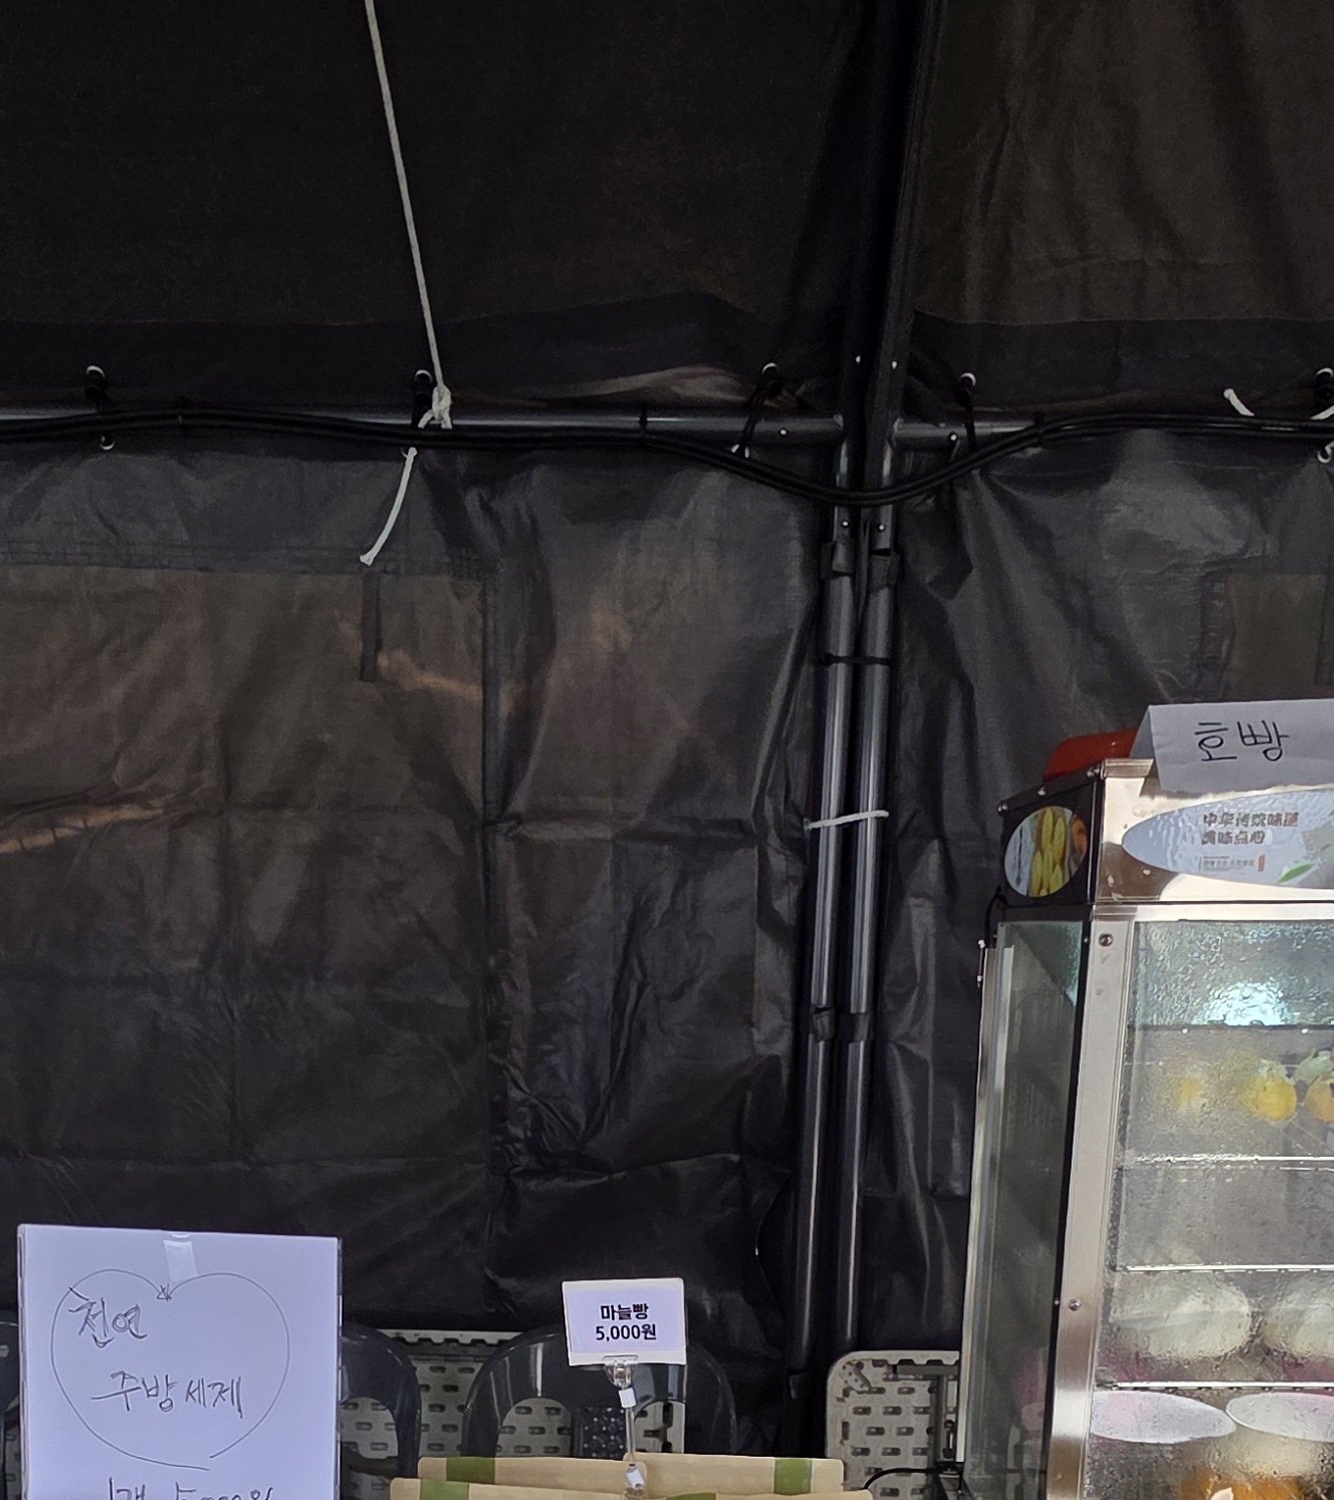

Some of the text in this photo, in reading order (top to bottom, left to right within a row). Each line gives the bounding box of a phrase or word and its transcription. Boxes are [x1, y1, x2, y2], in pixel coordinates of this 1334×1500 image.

[1193, 719, 1290, 762] 호빵
[67, 1285, 148, 1349] 천연
[600, 1303, 649, 1321] 마늘빵
[595, 1323, 657, 1342] 5,000원
